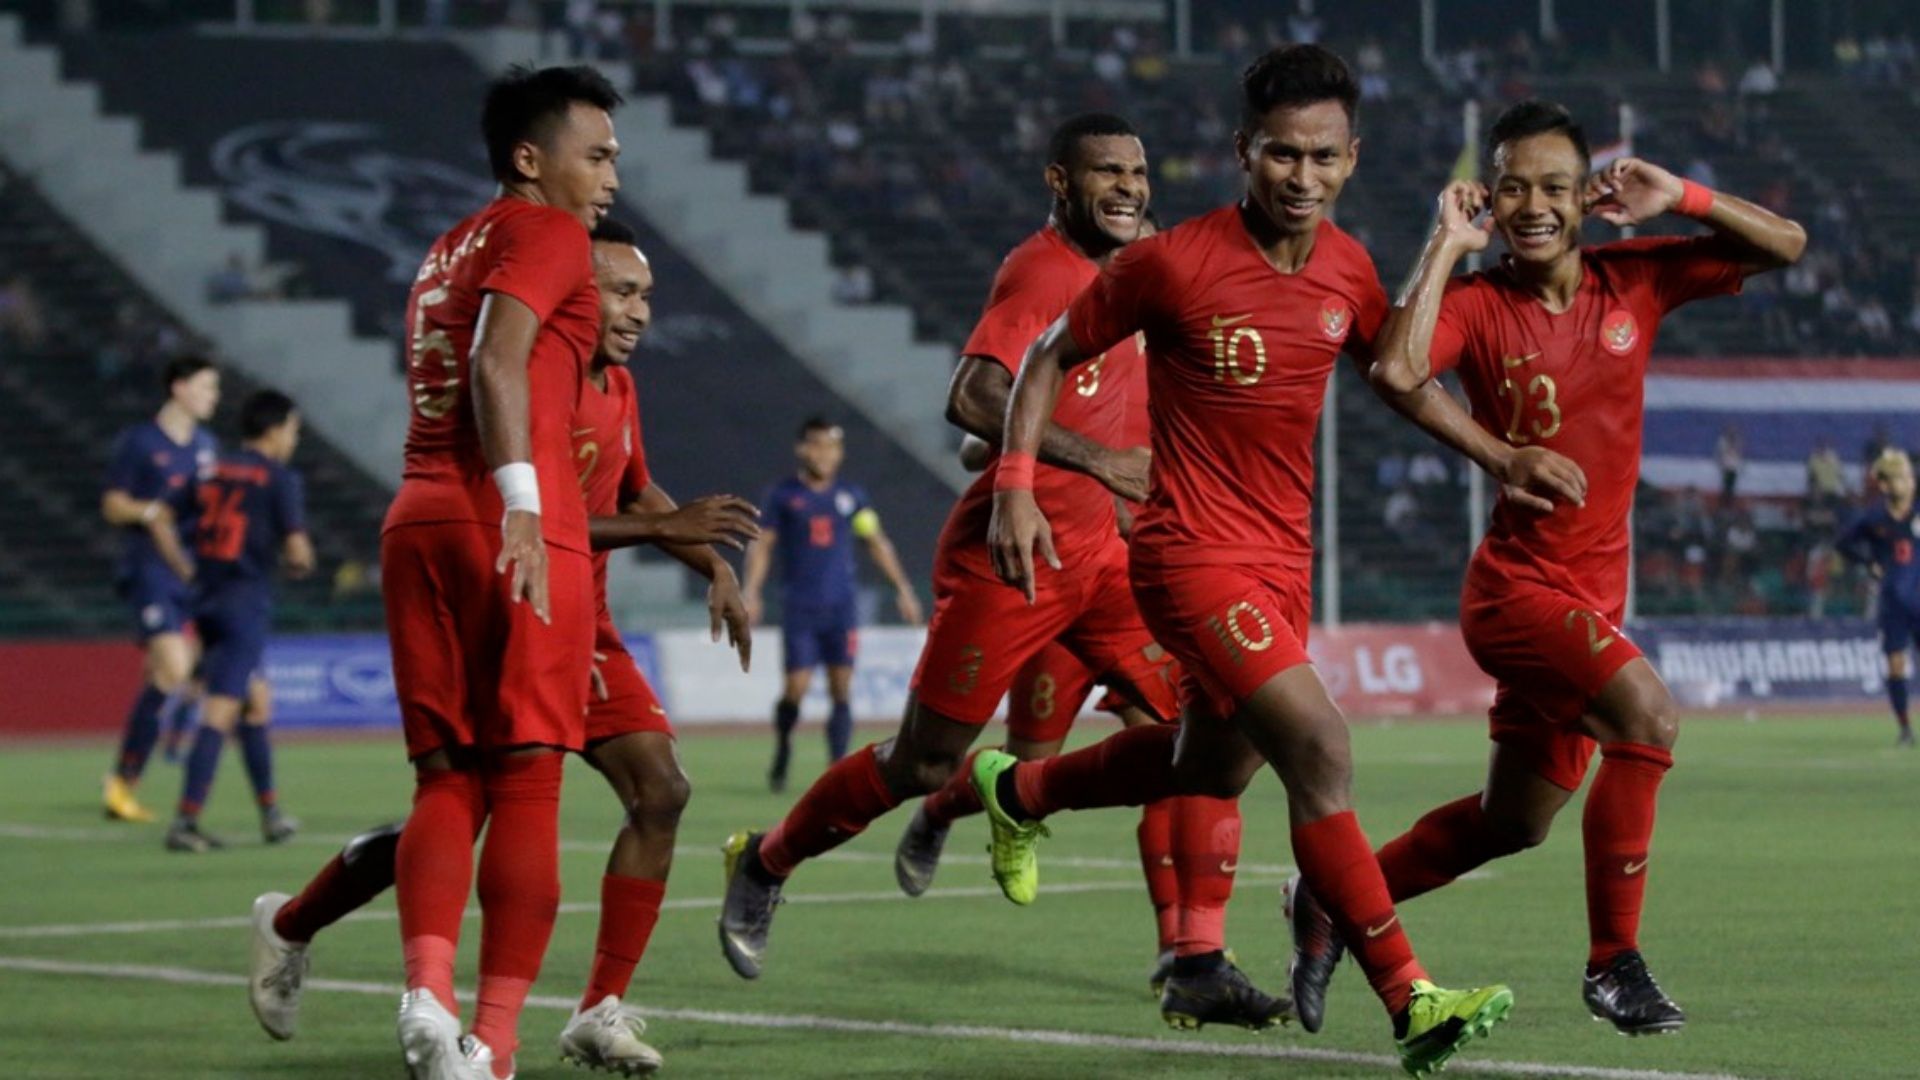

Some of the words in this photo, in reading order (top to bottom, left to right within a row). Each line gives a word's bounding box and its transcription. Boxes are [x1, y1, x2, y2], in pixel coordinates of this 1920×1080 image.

[1207, 327, 1266, 386] 10
[1498, 374, 1562, 443] 23
[1207, 600, 1274, 667] 10
[1031, 671, 1056, 720] 8
[1355, 643, 1423, 694] LG
